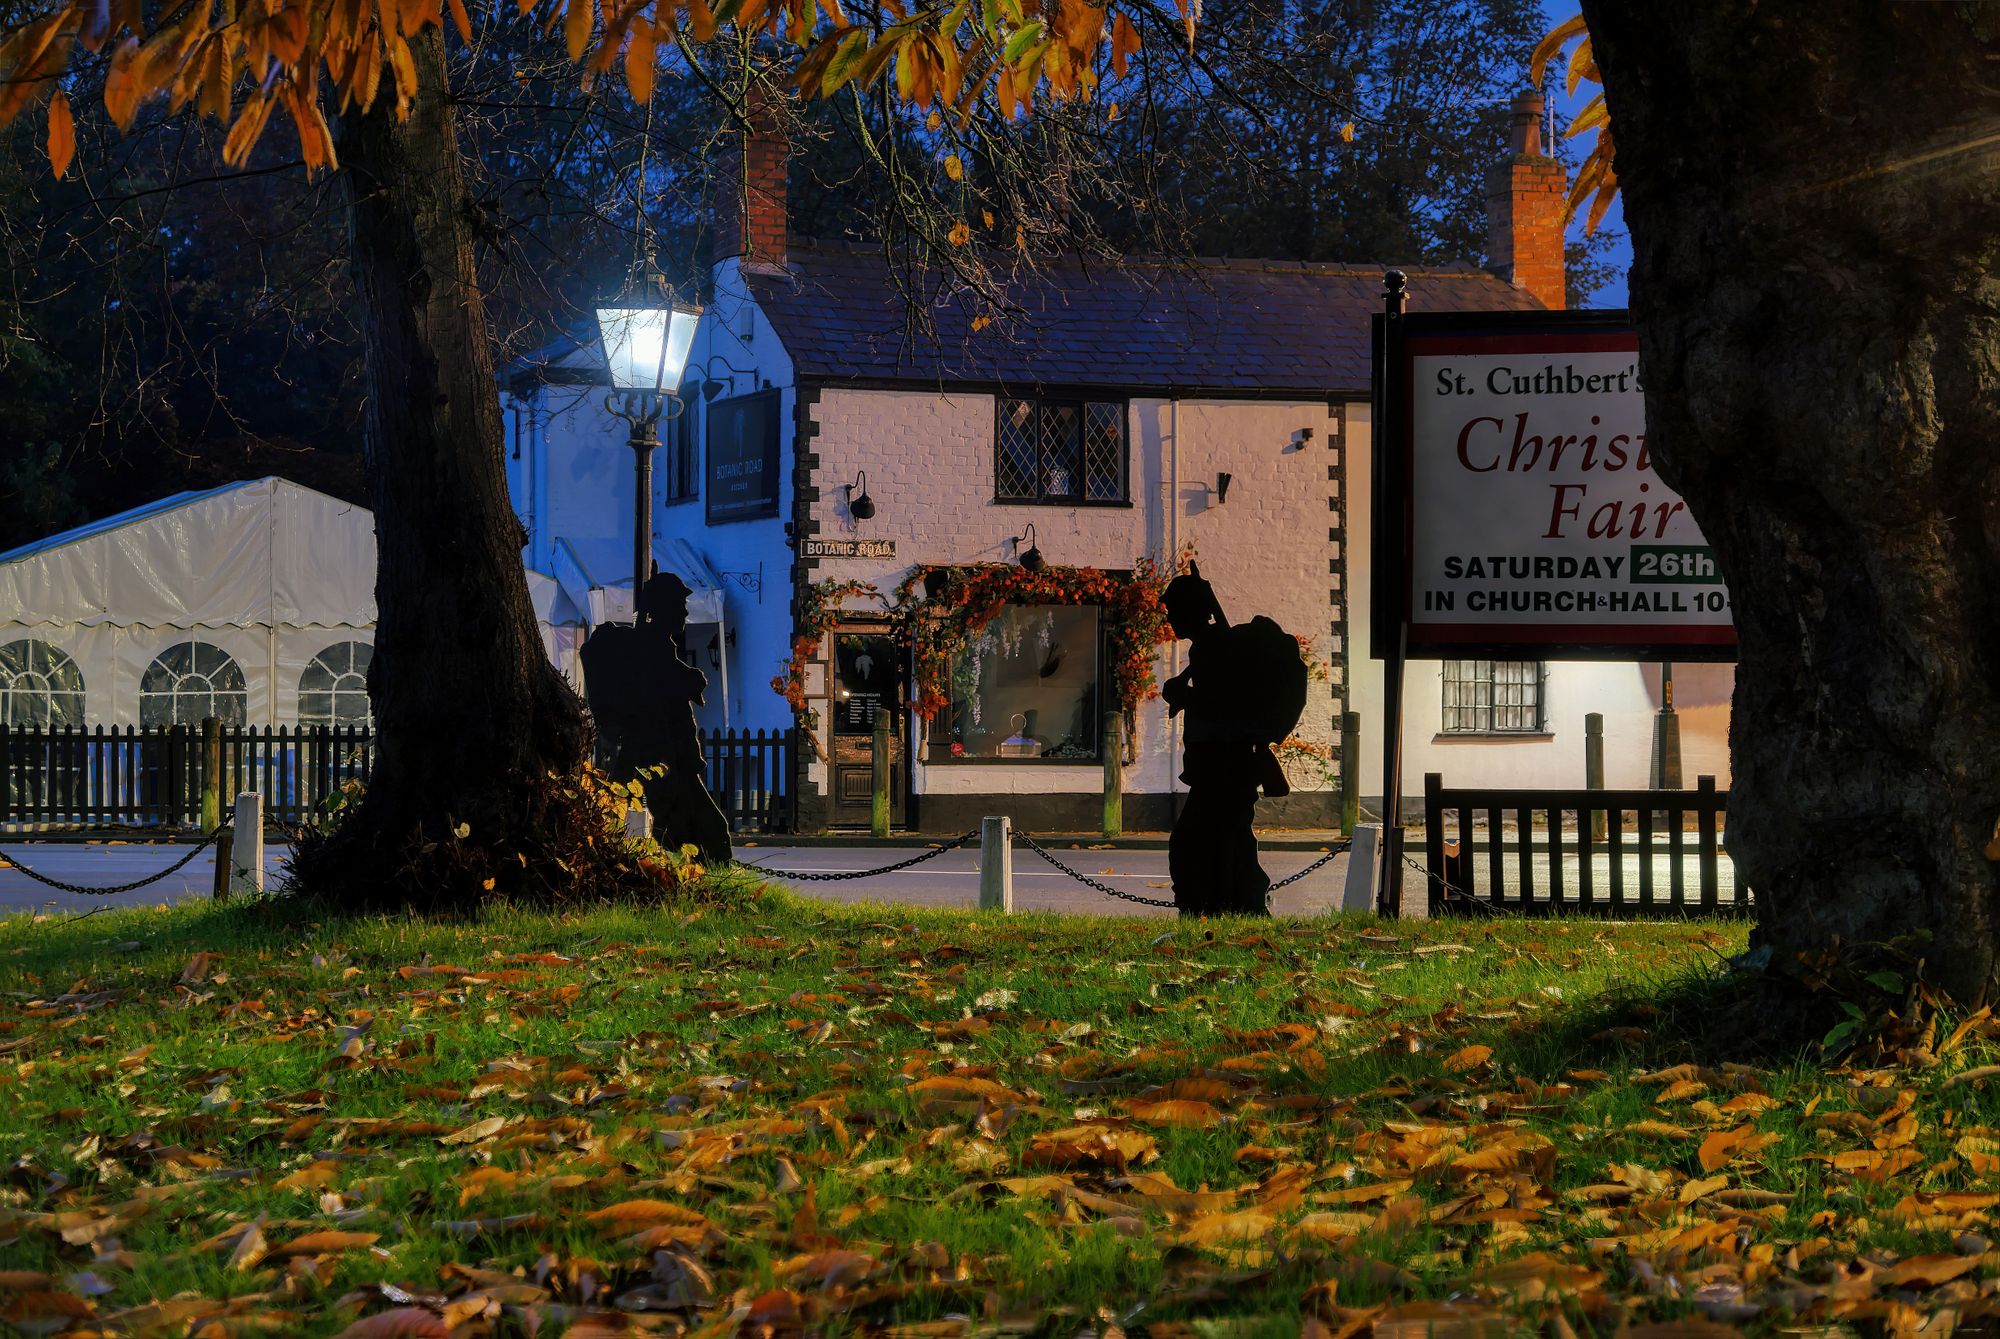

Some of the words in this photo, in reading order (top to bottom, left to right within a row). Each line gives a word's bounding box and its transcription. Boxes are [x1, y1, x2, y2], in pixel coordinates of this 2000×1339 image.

[1436, 367, 1475, 396] St.
[1541, 482, 1684, 540] Fair
[807, 543, 855, 555] BOTANIC
[859, 543, 890, 555] ROAD
[1444, 556, 1625, 580] SATURDAY
[1638, 552, 1715, 577] 26th
[1424, 590, 1454, 612] IN
